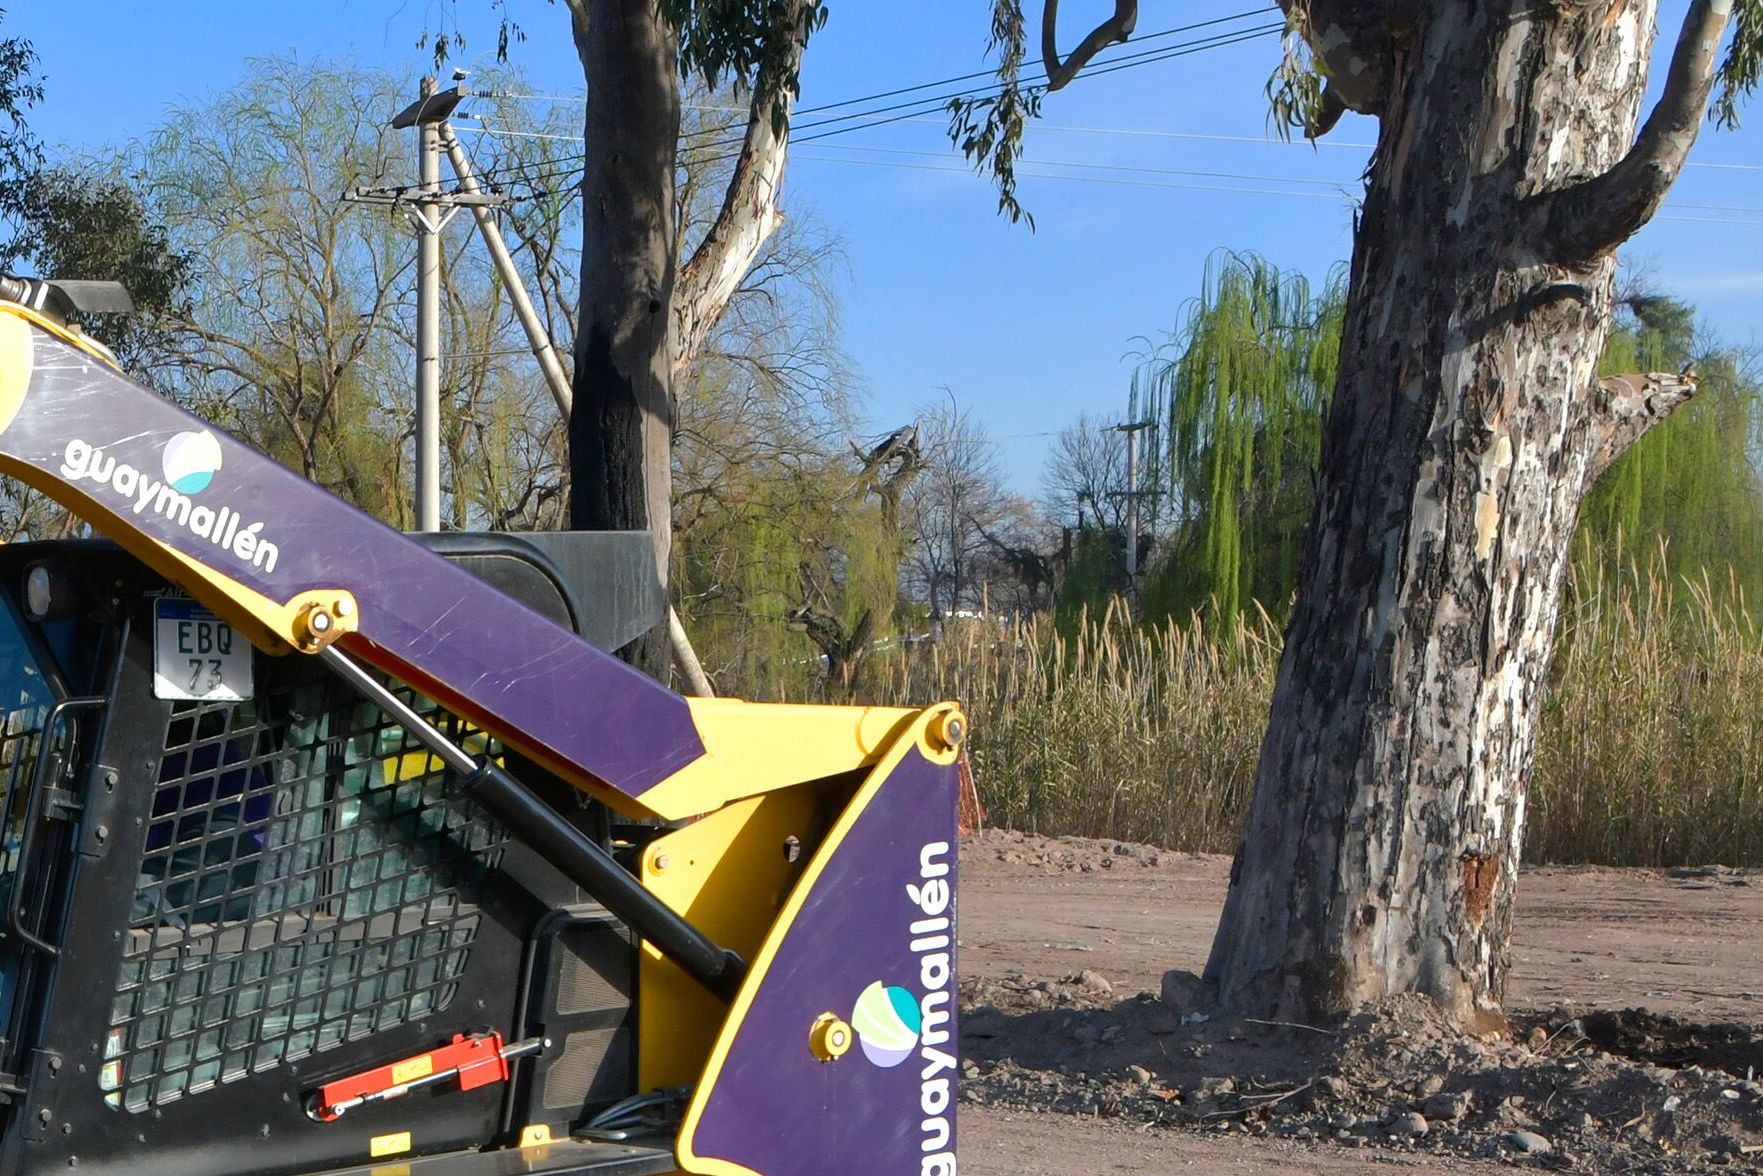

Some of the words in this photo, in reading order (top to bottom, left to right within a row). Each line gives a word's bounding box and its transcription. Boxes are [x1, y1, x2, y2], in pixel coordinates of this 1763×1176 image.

[60, 438, 280, 574] guaymallén
[178, 621, 233, 655] EBQ
[188, 658, 222, 691] 73
